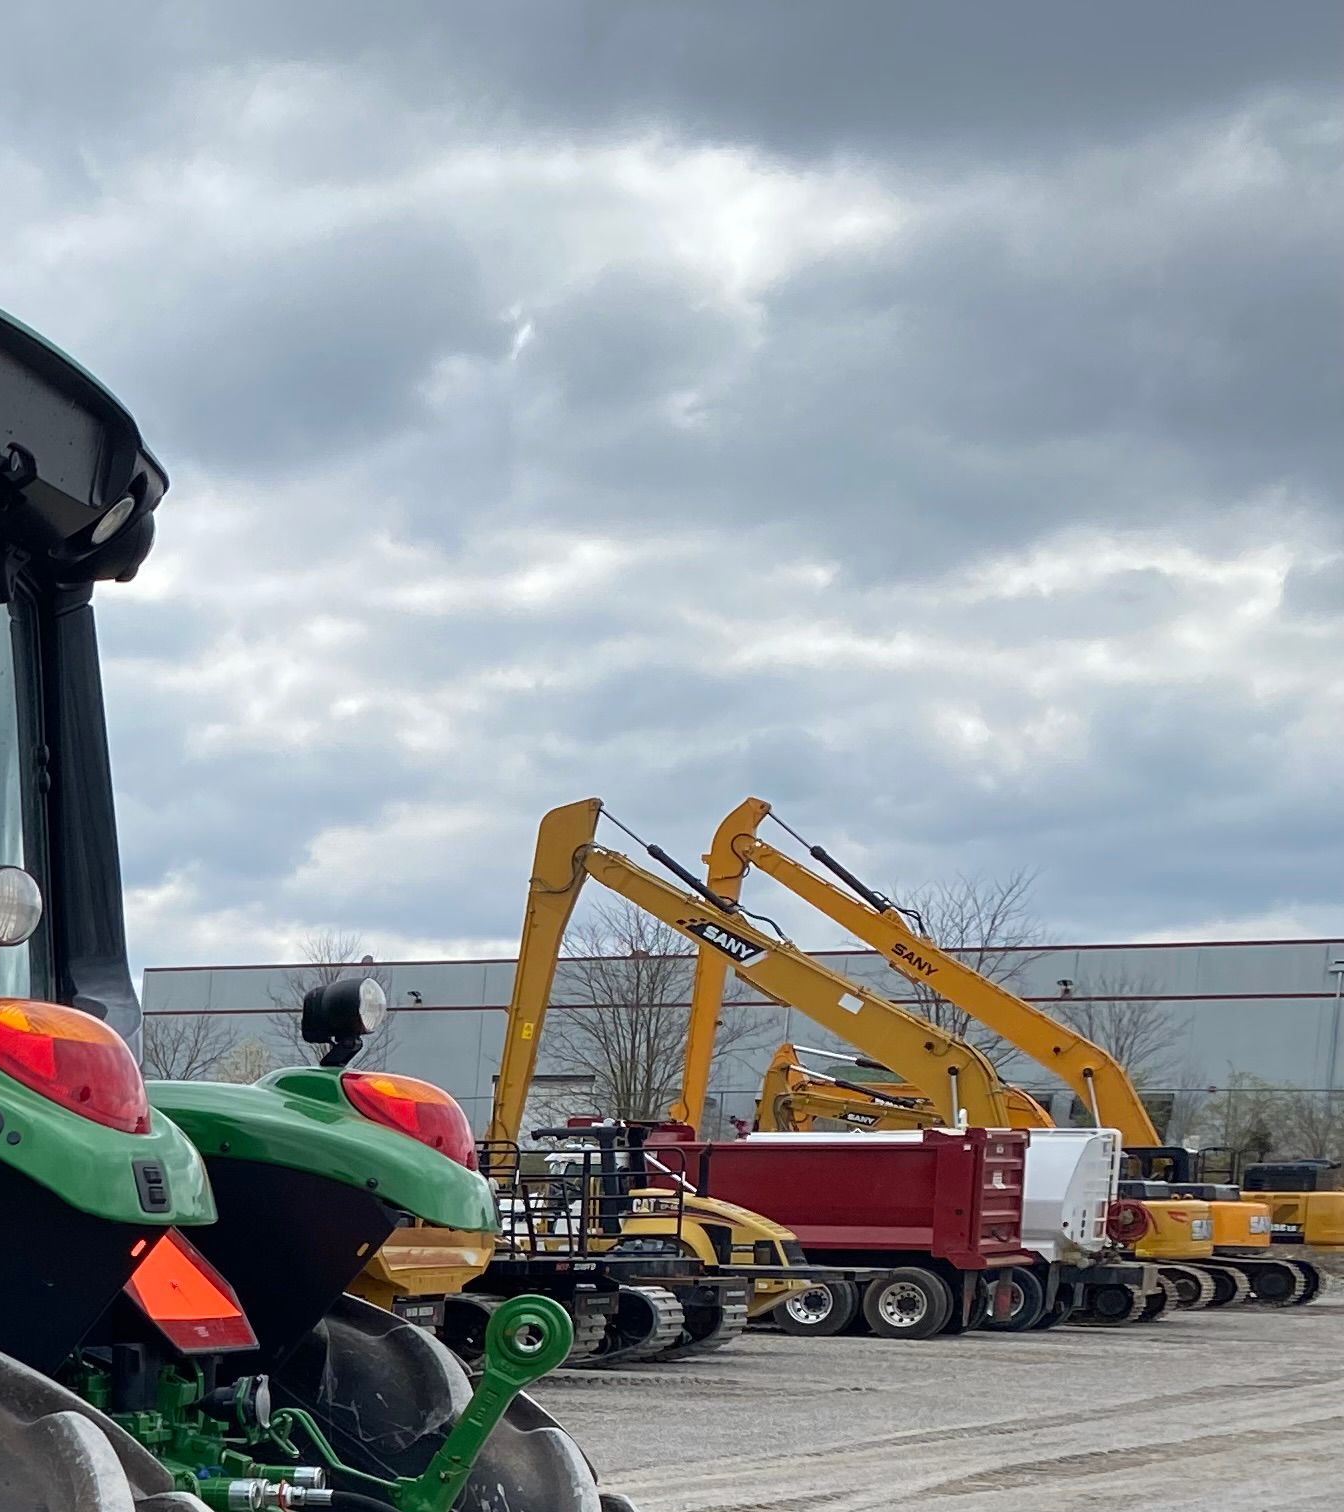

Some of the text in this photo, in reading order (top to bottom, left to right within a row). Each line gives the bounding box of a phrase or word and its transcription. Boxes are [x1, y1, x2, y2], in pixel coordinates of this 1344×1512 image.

[702, 925, 755, 958] SANY
[891, 943, 939, 976] SANY
[846, 1112, 876, 1125] SANY
[632, 1198, 657, 1214] CAT
